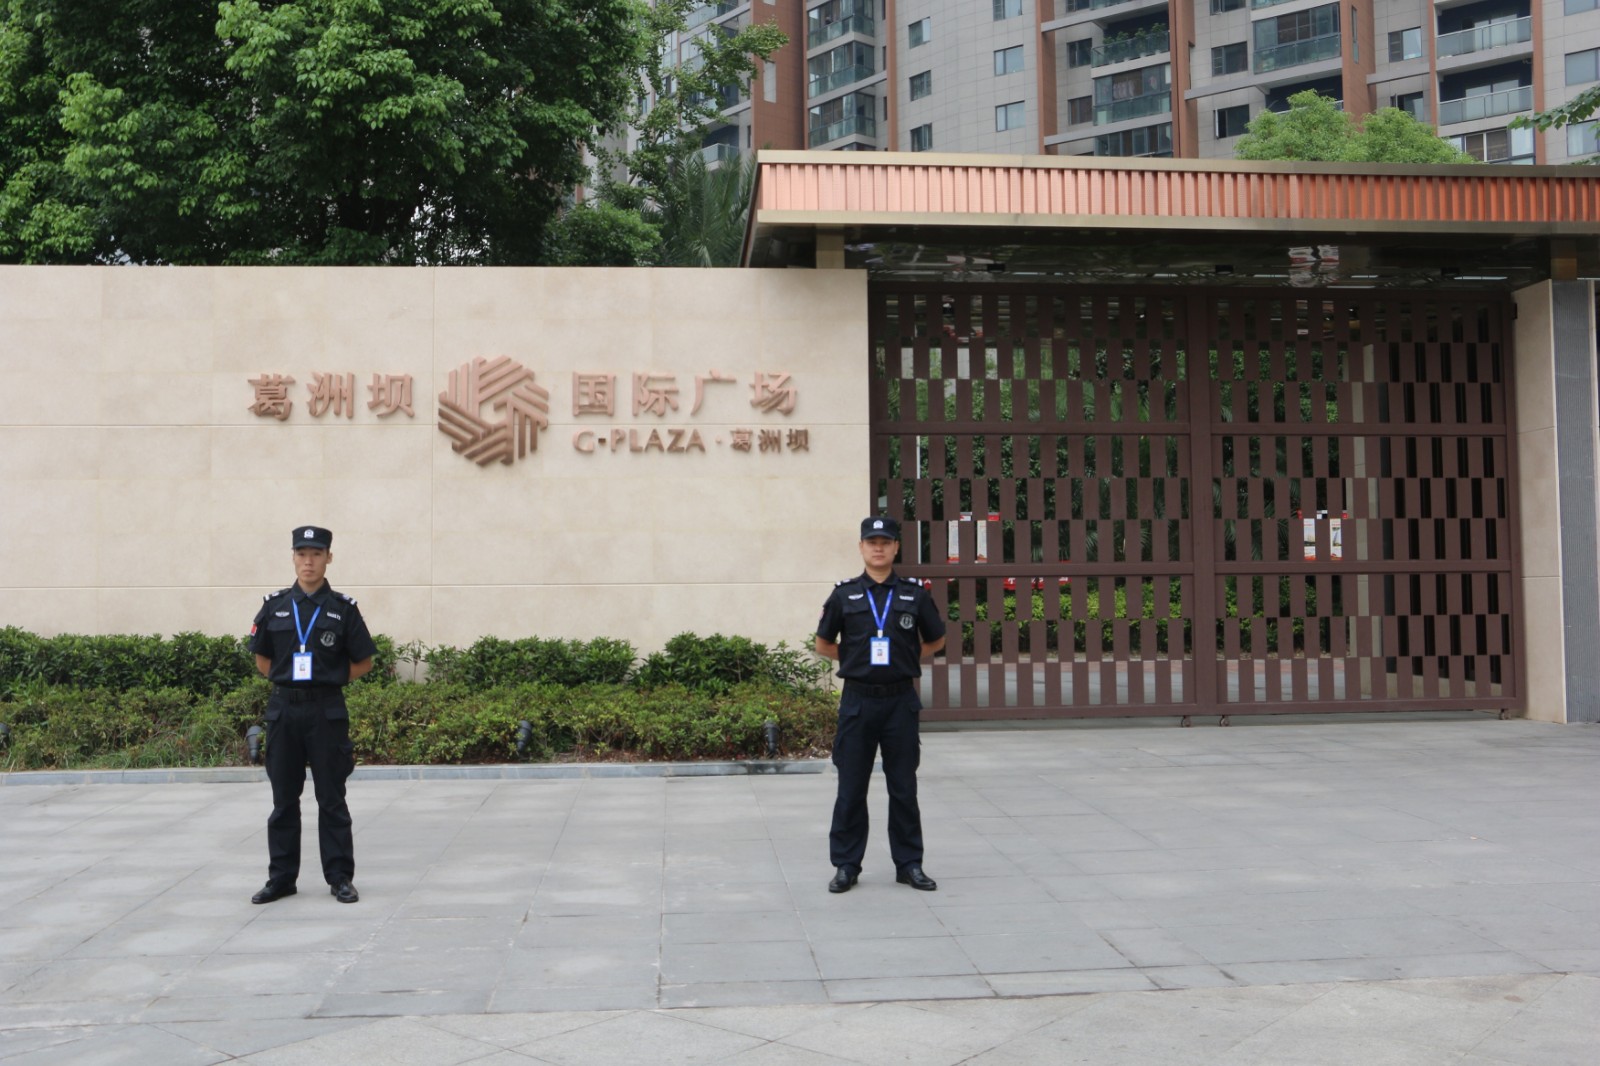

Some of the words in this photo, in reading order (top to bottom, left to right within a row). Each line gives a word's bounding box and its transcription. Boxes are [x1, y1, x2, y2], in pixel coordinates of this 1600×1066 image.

[247, 372, 415, 421] 葛洲坝
[572, 368, 798, 417] 国际广场
